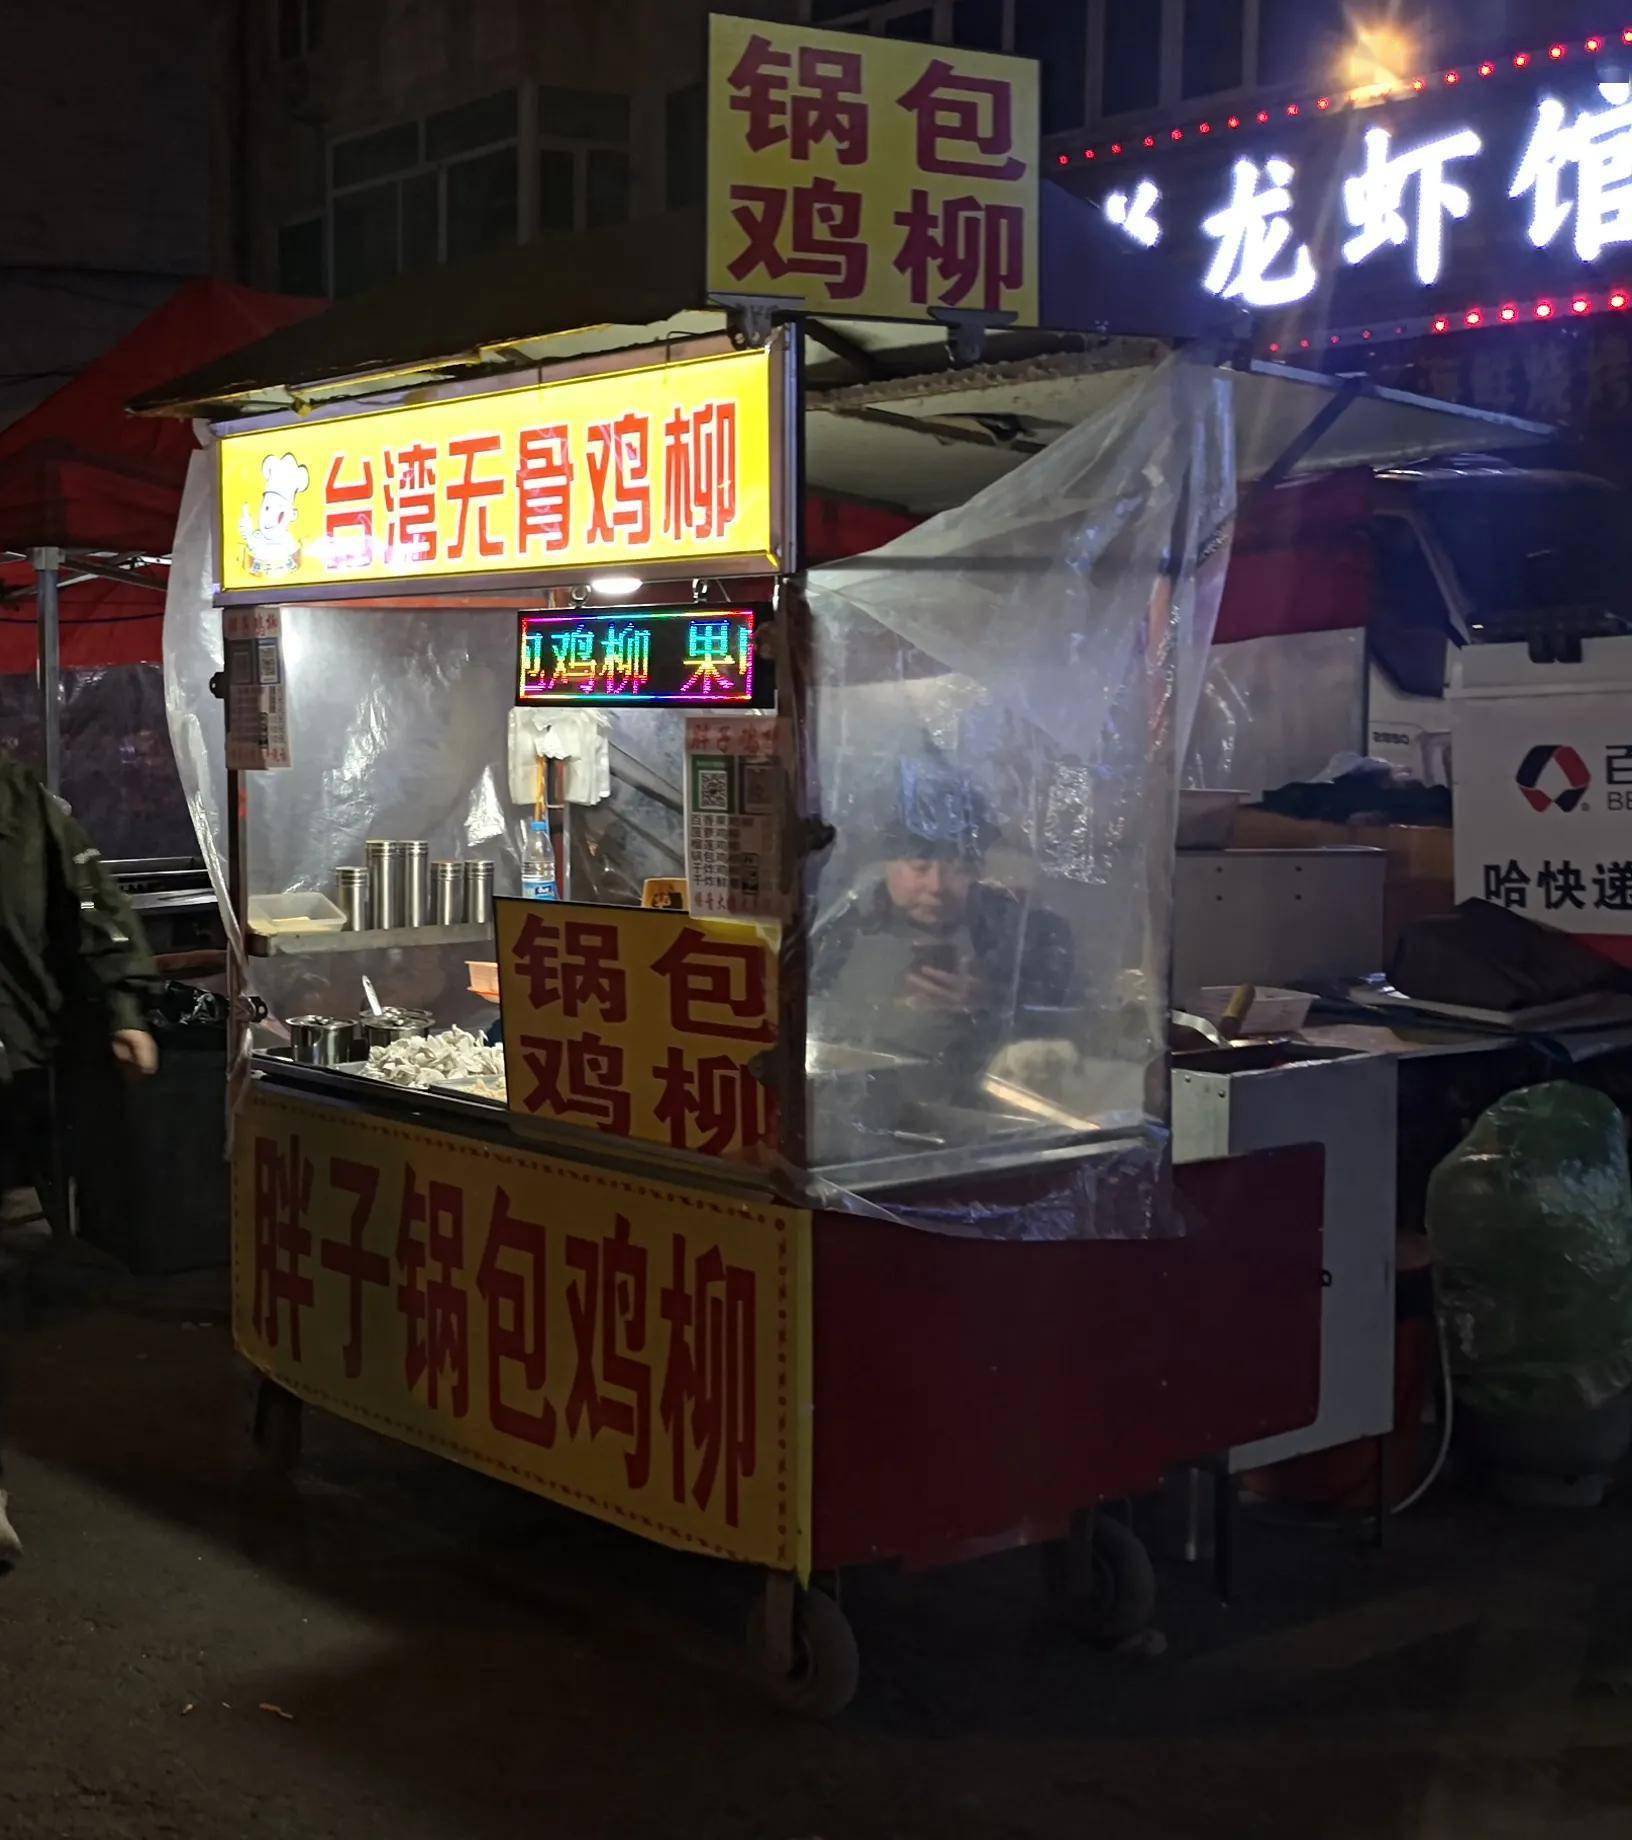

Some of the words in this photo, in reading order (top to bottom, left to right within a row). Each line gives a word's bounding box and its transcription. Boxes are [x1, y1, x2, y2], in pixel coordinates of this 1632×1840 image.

[728, 34, 1025, 180] 锅包
[728, 177, 1024, 311] 鸡柳
[1106, 84, 1632, 306] 龙虾馆
[325, 403, 736, 568] 台湾无骨鸡柳
[681, 620, 751, 694] 果
[1483, 859, 1632, 909] 哈快递
[514, 912, 778, 1044] 锅包
[520, 1032, 776, 1156] 鸡柳
[252, 1134, 757, 1528] 胖子锅包鸡柳
